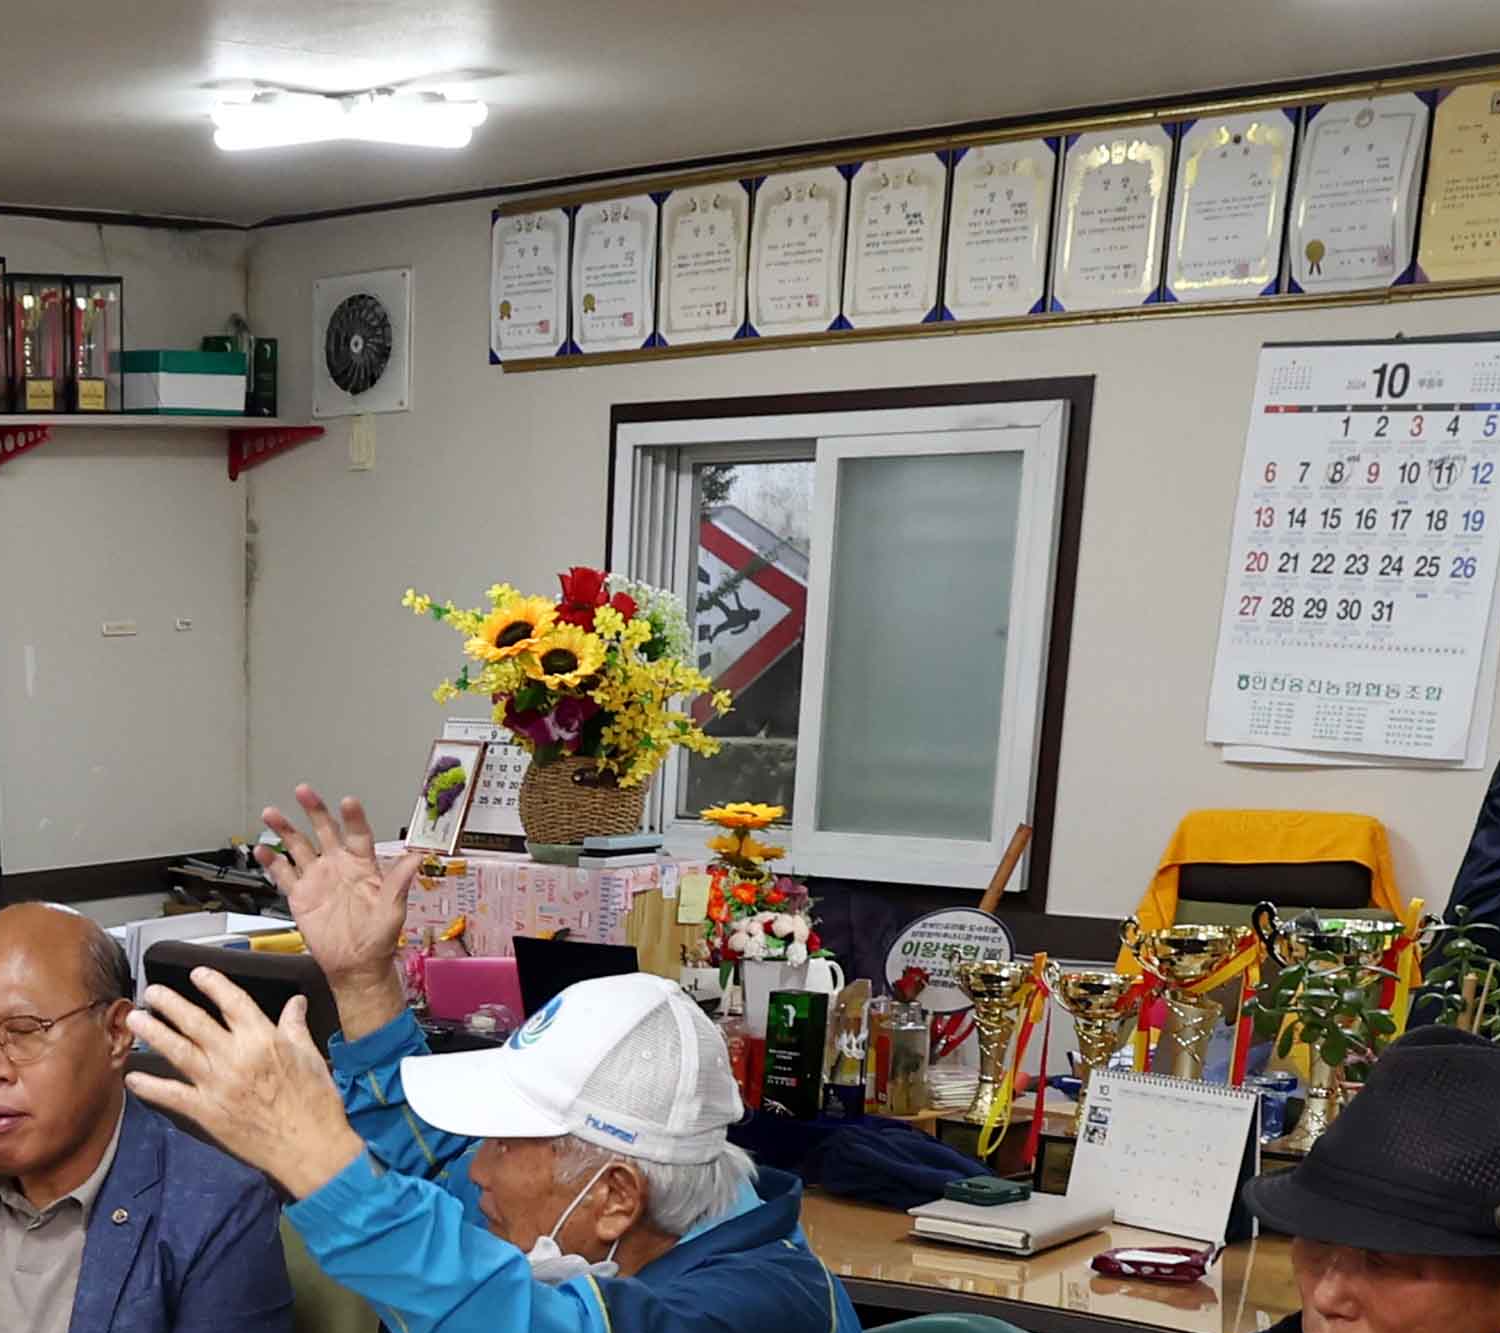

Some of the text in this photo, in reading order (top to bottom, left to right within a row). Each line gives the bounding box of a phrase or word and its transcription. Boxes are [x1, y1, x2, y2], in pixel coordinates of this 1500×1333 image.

[1373, 363, 1410, 398] 10
[1343, 415, 1498, 437] 1 2 3 4 5
[1265, 462, 1277, 483] 6
[1299, 462, 1310, 482] 7
[1367, 462, 1380, 483] 9
[1400, 462, 1420, 484] 10
[1472, 462, 1493, 484] 12
[1256, 507, 1484, 531] 13 14 15 16 17 18 19
[1245, 552, 1477, 578] 20 21 22 23 24 25 26
[1239, 596, 1393, 621] 27 28 29 30 31
